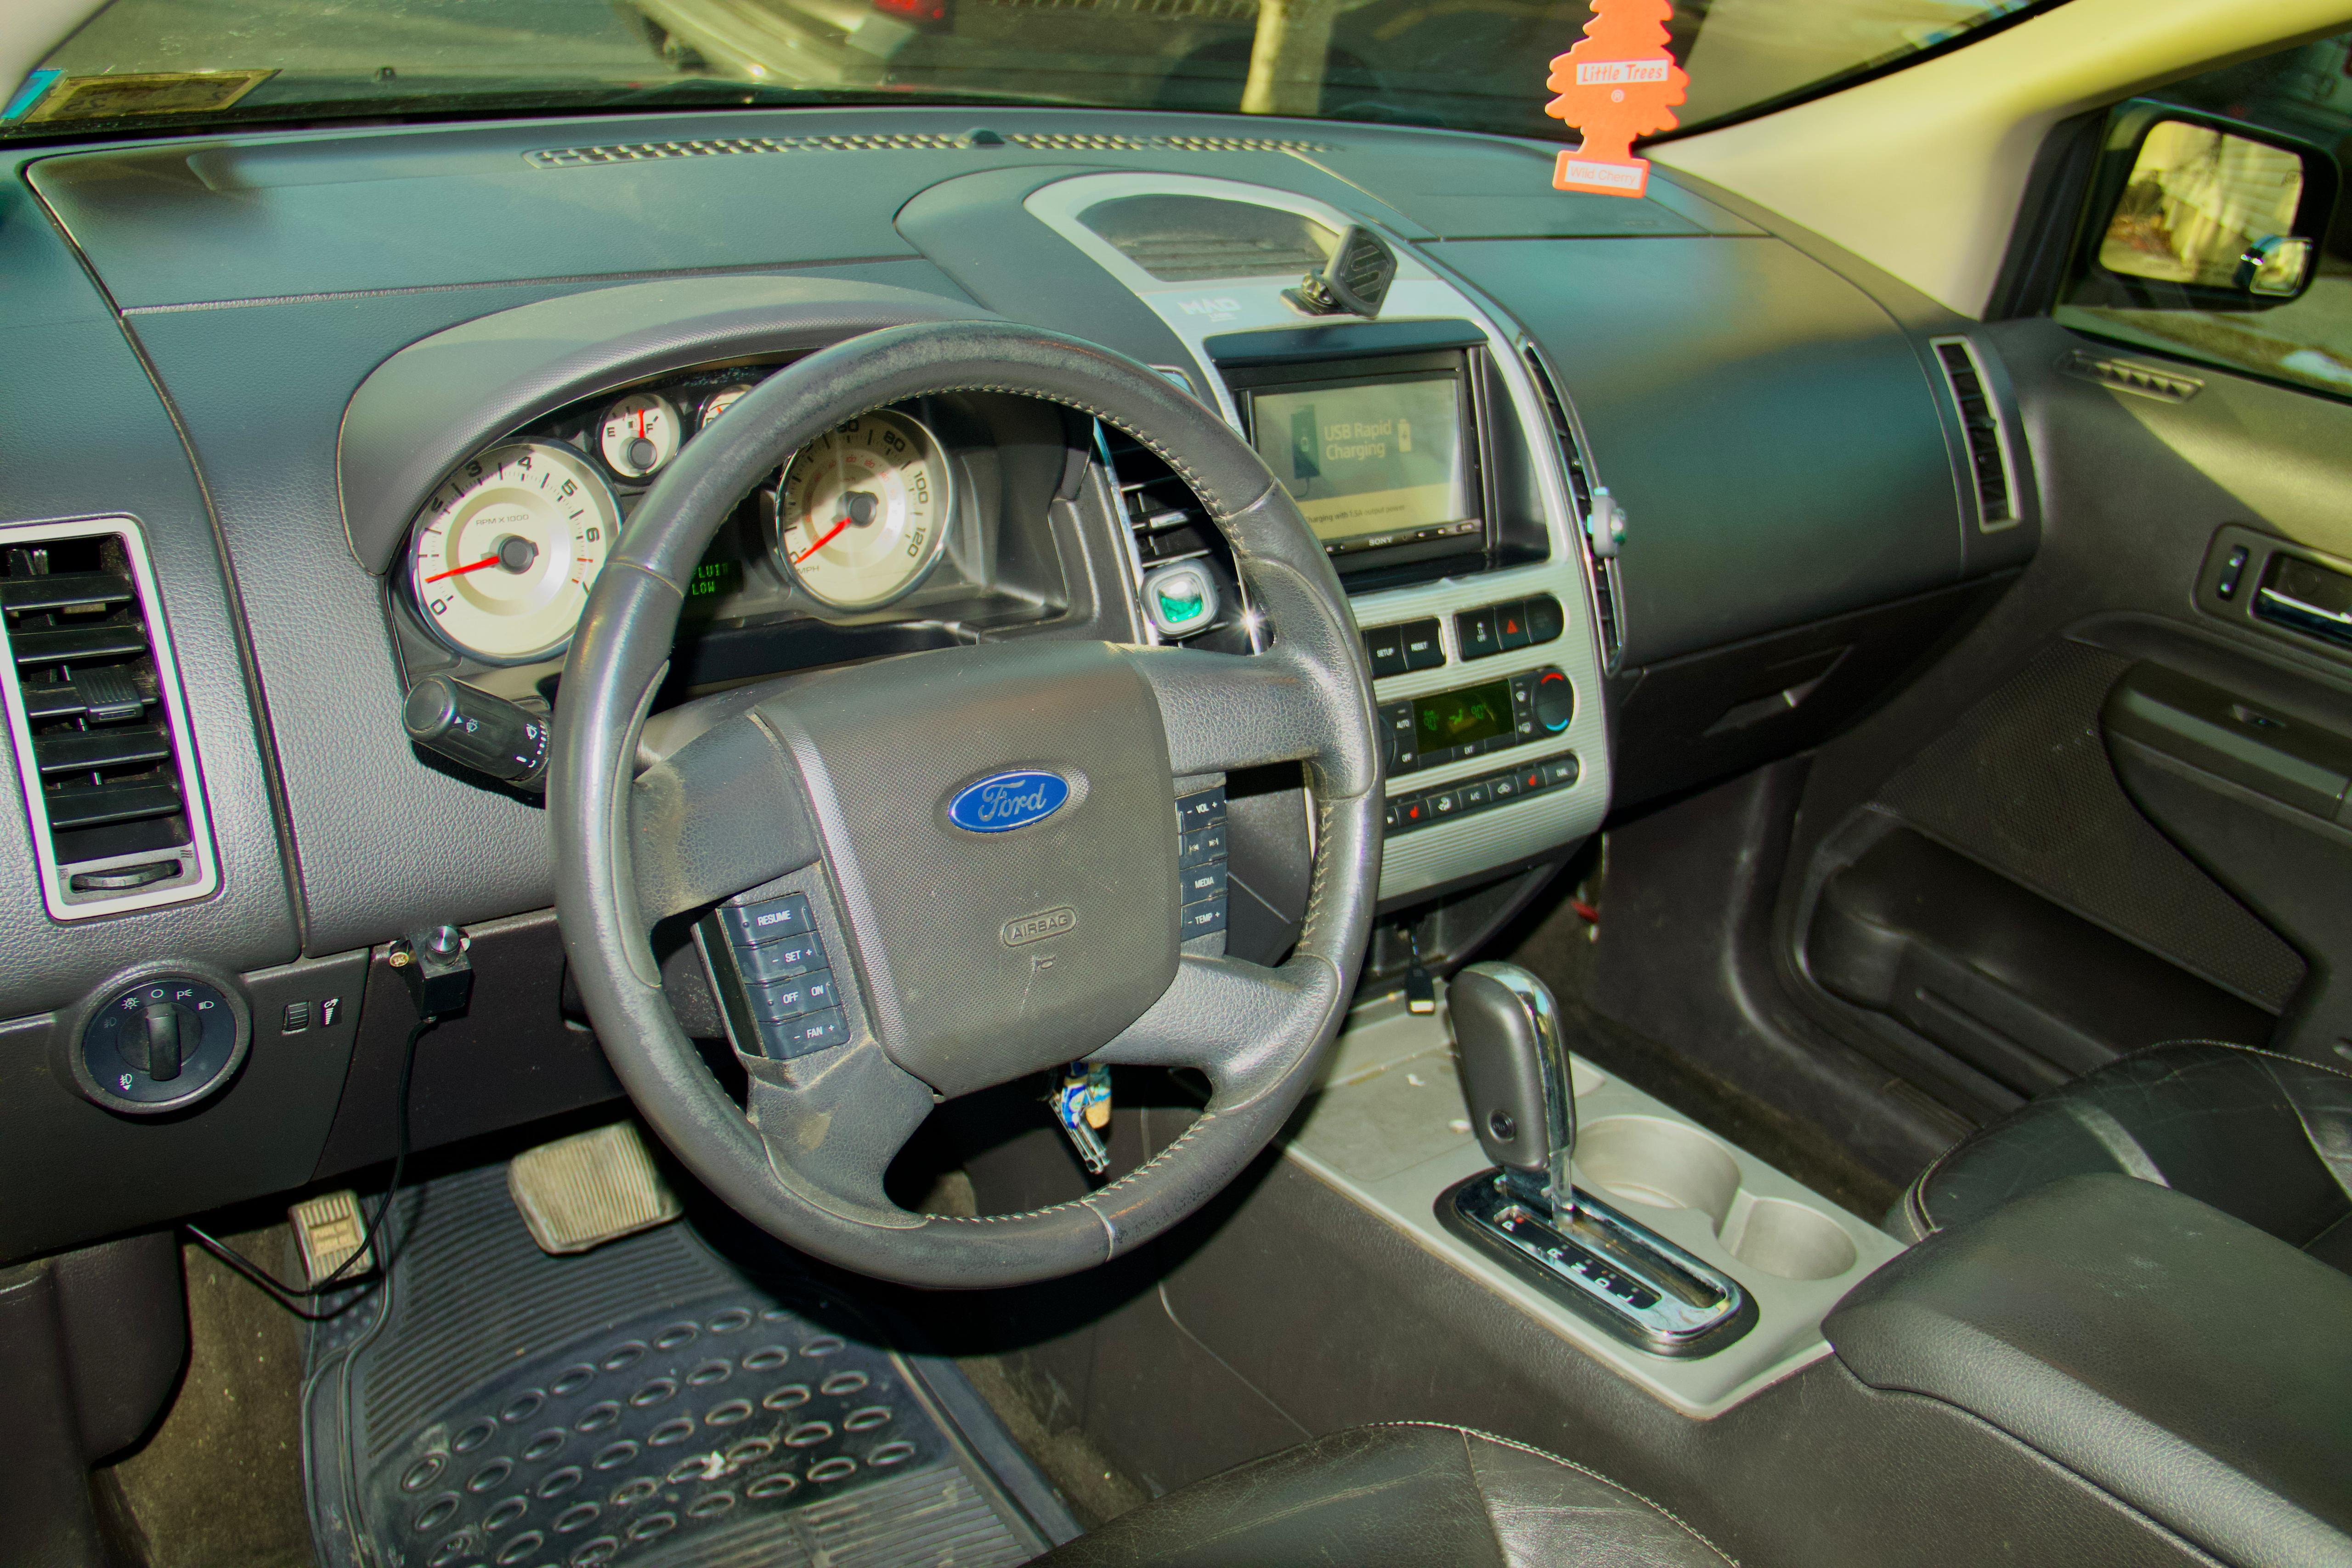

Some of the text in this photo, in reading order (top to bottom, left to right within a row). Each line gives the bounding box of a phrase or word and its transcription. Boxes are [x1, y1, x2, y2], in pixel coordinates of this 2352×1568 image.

[1582, 64, 1663, 82] Little Trees
[1570, 165, 1636, 185] Wild Cherry
[606, 427, 616, 437] E
[645, 423, 654, 434] F
[1324, 419, 1391, 441] USB Rapid
[883, 430, 905, 452] 80
[1326, 441, 1385, 461] Charging
[466, 461, 482, 478] 3
[517, 456, 532, 471] 4
[560, 479, 578, 496] 5
[914, 470, 928, 504] 100
[507, 514, 529, 522] 1000
[586, 527, 600, 542] 6
[907, 526, 927, 558] 120
[1368, 536, 1393, 546] SONY
[797, 565, 820, 574] MPH
[692, 581, 716, 596] LOW
[430, 598, 447, 615] 0
[1377, 647, 1394, 657] SETUP
[1411, 642, 1427, 652] RESET
[1396, 719, 1410, 729] AUTO
[1402, 753, 1413, 762] OFF
[978, 780, 1047, 822] Ford
[1195, 803, 1210, 814] VOL
[1195, 876, 1215, 888] MEDIA
[758, 910, 792, 926] RESUME
[1195, 913, 1213, 925] TEMP
[1012, 914, 1068, 940] AIRBAG
[785, 950, 801, 963] SET
[783, 986, 824, 1004] OFF ON
[807, 1026, 823, 1038] FAN
[1502, 1220, 1515, 1232] P
[1547, 1247, 1563, 1259] R
[1571, 1262, 1588, 1274] N
[1594, 1277, 1611, 1289] D
[1617, 1293, 1634, 1303] L
